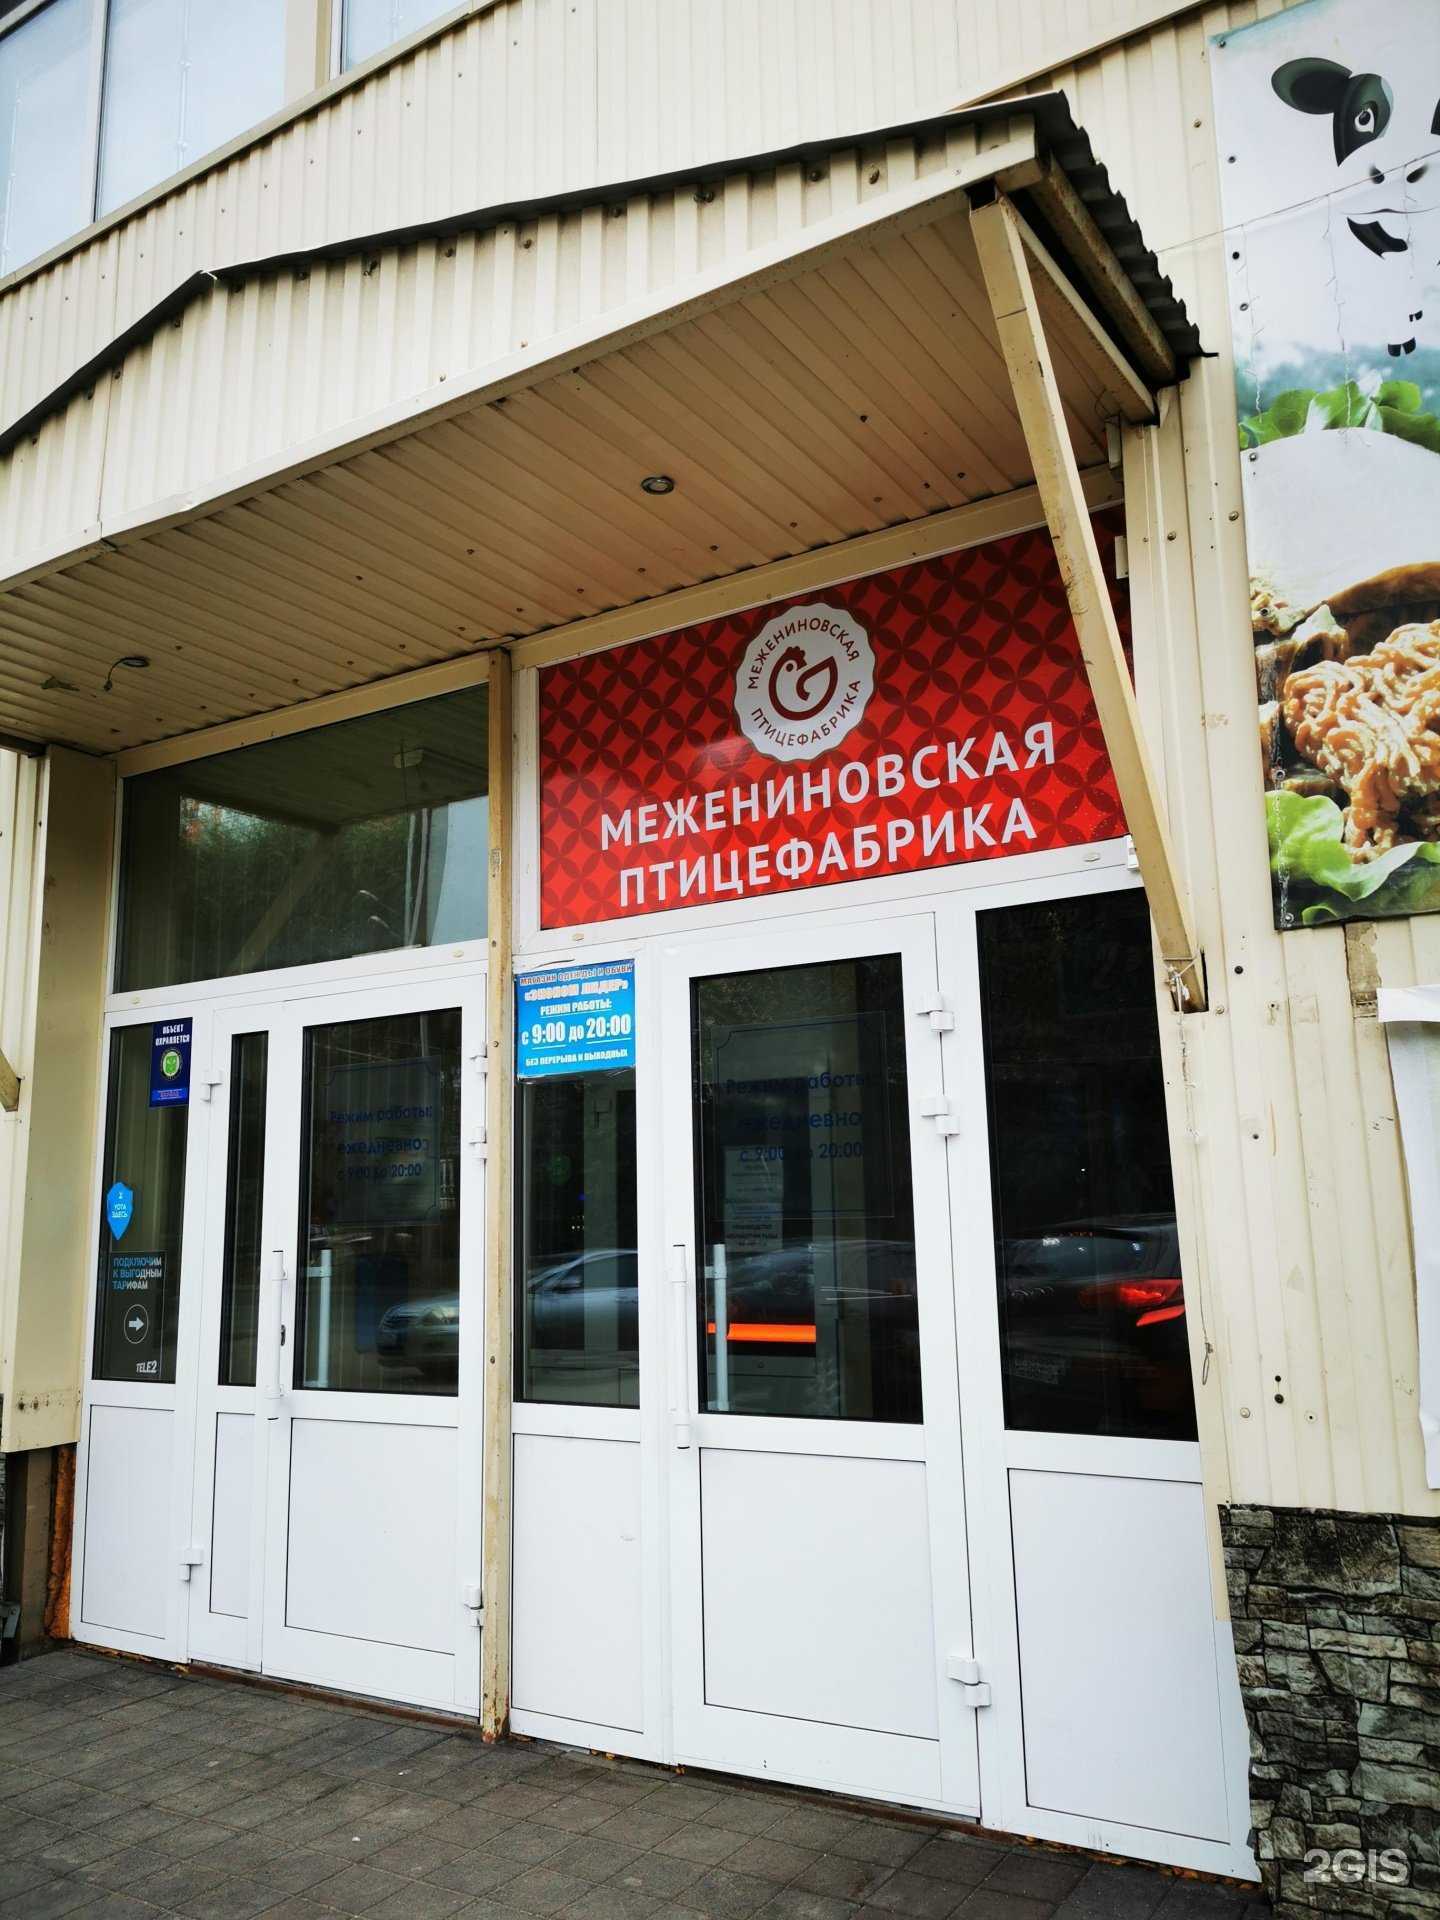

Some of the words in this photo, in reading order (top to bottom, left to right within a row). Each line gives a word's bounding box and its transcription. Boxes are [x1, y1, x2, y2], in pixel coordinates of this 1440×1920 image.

[748, 617, 860, 690] МЕЖЕНИНОВСКАЯ
[751, 680, 861, 748] ПТИЦЕФАБРИКА
[601, 721, 1057, 851] МЕЖЕНИНОВСКАЯ
[620, 798, 1037, 907] ПТИЦЕФАБРИКА
[541, 1002, 571, 1015] РЕЖИМ
[572, 998, 612, 1012] РАБОТЫ:
[163, 1024, 184, 1034] ОБЪЕКТ
[532, 1021, 566, 1045] 9:00
[586, 1014, 632, 1039] 20:00
[155, 1034, 190, 1046] ОХРАНЯЕТСЯ
[818, 1141, 863, 1158] 20:00
[391, 1162, 422, 1177] 20:00
[112, 1210, 128, 1218] ЗДЕСЬ
[113, 1256, 162, 1269] ПОДКЛЮЧИМ
[113, 1269, 119, 1279] К
[120, 1268, 162, 1280] ВЫГОДНЫМ
[113, 1280, 148, 1291] ТАРИФАМ
[136, 1360, 158, 1374] TELE2
